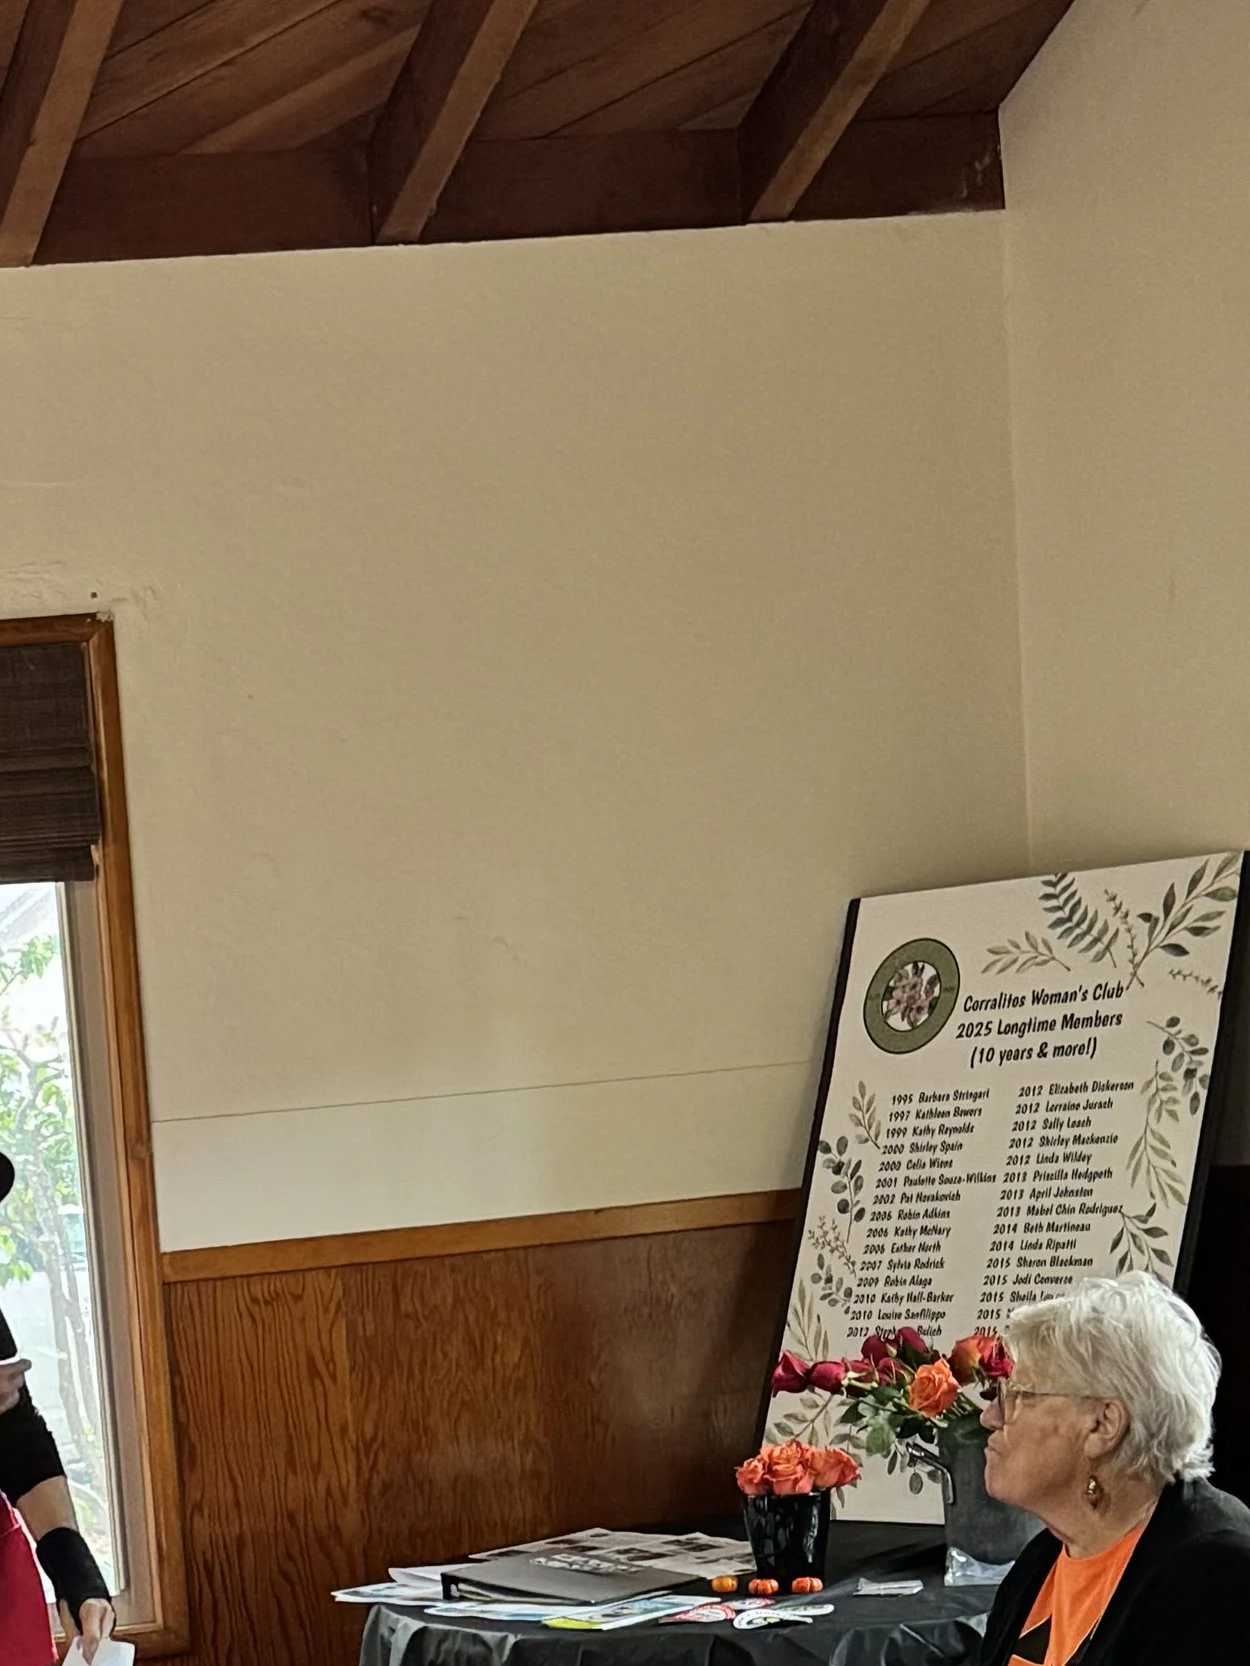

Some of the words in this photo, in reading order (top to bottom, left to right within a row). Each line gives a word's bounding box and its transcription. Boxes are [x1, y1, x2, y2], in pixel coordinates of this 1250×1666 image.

[963, 991, 1026, 1013] Corralitos
[1031, 985, 1088, 1006] Woman's
[1093, 980, 1125, 1001] Club
[955, 1020, 993, 1039] 2025
[997, 1017, 1056, 1039] Longtime
[1061, 1009, 1123, 1031] Members
[970, 1046, 995, 1069] (10
[999, 1047, 1033, 1067] years
[1037, 1041, 1048, 1058] &
[1052, 1036, 1097, 1060] more!)
[1018, 1085, 1043, 1098] 2012
[1048, 1081, 1089, 1096] Elizabeth
[1091, 1080, 1134, 1093] Dickerson
[892, 1093, 913, 1106] 1995
[918, 1091, 950, 1104] Barbara
[888, 1110, 911, 1122] 1997
[915, 1107, 951, 1120] Kathleen
[953, 1106, 982, 1118] Bowers
[1015, 1102, 1040, 1115] 2012
[1045, 1101, 1081, 1113] Lorraine
[886, 1127, 908, 1139] 1999
[912, 1124, 936, 1138] Kathy
[938, 1121, 975, 1138] Reynolds
[1012, 1120, 1037, 1132] 2012
[1042, 1117, 1064, 1132] Sally
[881, 1143, 905, 1155] 2000
[909, 1141, 938, 1156] Shirley
[939, 1140, 963, 1155] Spain
[1009, 1137, 1034, 1149] 2012
[1039, 1135, 1070, 1149] Shirley
[878, 1160, 902, 1172] 2000
[1006, 1155, 1031, 1166] 2012
[1036, 1152, 1059, 1164] Linda
[875, 1177, 898, 1189] 2001
[903, 1175, 936, 1187] Paulette
[1003, 1171, 1027, 1183] 2013
[1033, 1169, 1068, 1182] Priscilla
[872, 1193, 896, 1205] 2002
[900, 1192, 914, 1204] Pat
[1000, 1189, 1024, 1200] 2013
[1029, 1187, 1051, 1202] April
[1053, 1186, 1093, 1198] Johnston
[897, 1208, 921, 1221] Robin
[922, 1207, 951, 1220] Adkins
[997, 1206, 1021, 1218] 2013
[1026, 1204, 1053, 1216] Mabel
[1055, 1204, 1076, 1216] Chin
[1078, 1202, 1123, 1218] Rodriguez
[894, 1225, 918, 1239] Kathy
[993, 1223, 1018, 1235] 2014
[1023, 1221, 1044, 1234] Beth
[890, 1242, 916, 1254] Esther
[918, 1240, 942, 1253] North
[989, 1240, 1014, 1251] 2014
[1020, 1238, 1043, 1250] Linda
[886, 1258, 911, 1273] Sylvia
[986, 1258, 1011, 1269] 2015
[1016, 1256, 1047, 1268] Sharon
[1049, 1255, 1094, 1268] Blackman
[883, 1275, 907, 1287] Robin
[983, 1275, 1008, 1286] 2015
[1012, 1273, 1031, 1285] Jodi
[1034, 1273, 1073, 1285] Converse
[853, 1293, 876, 1304] 2010
[880, 1292, 905, 1307] Kathy
[979, 1292, 1004, 1303] 2015
[1009, 1290, 1037, 1303] Sheila
[850, 1310, 873, 1321] 2010
[877, 1308, 902, 1320] Louise
[977, 1309, 1001, 1320] 2015
